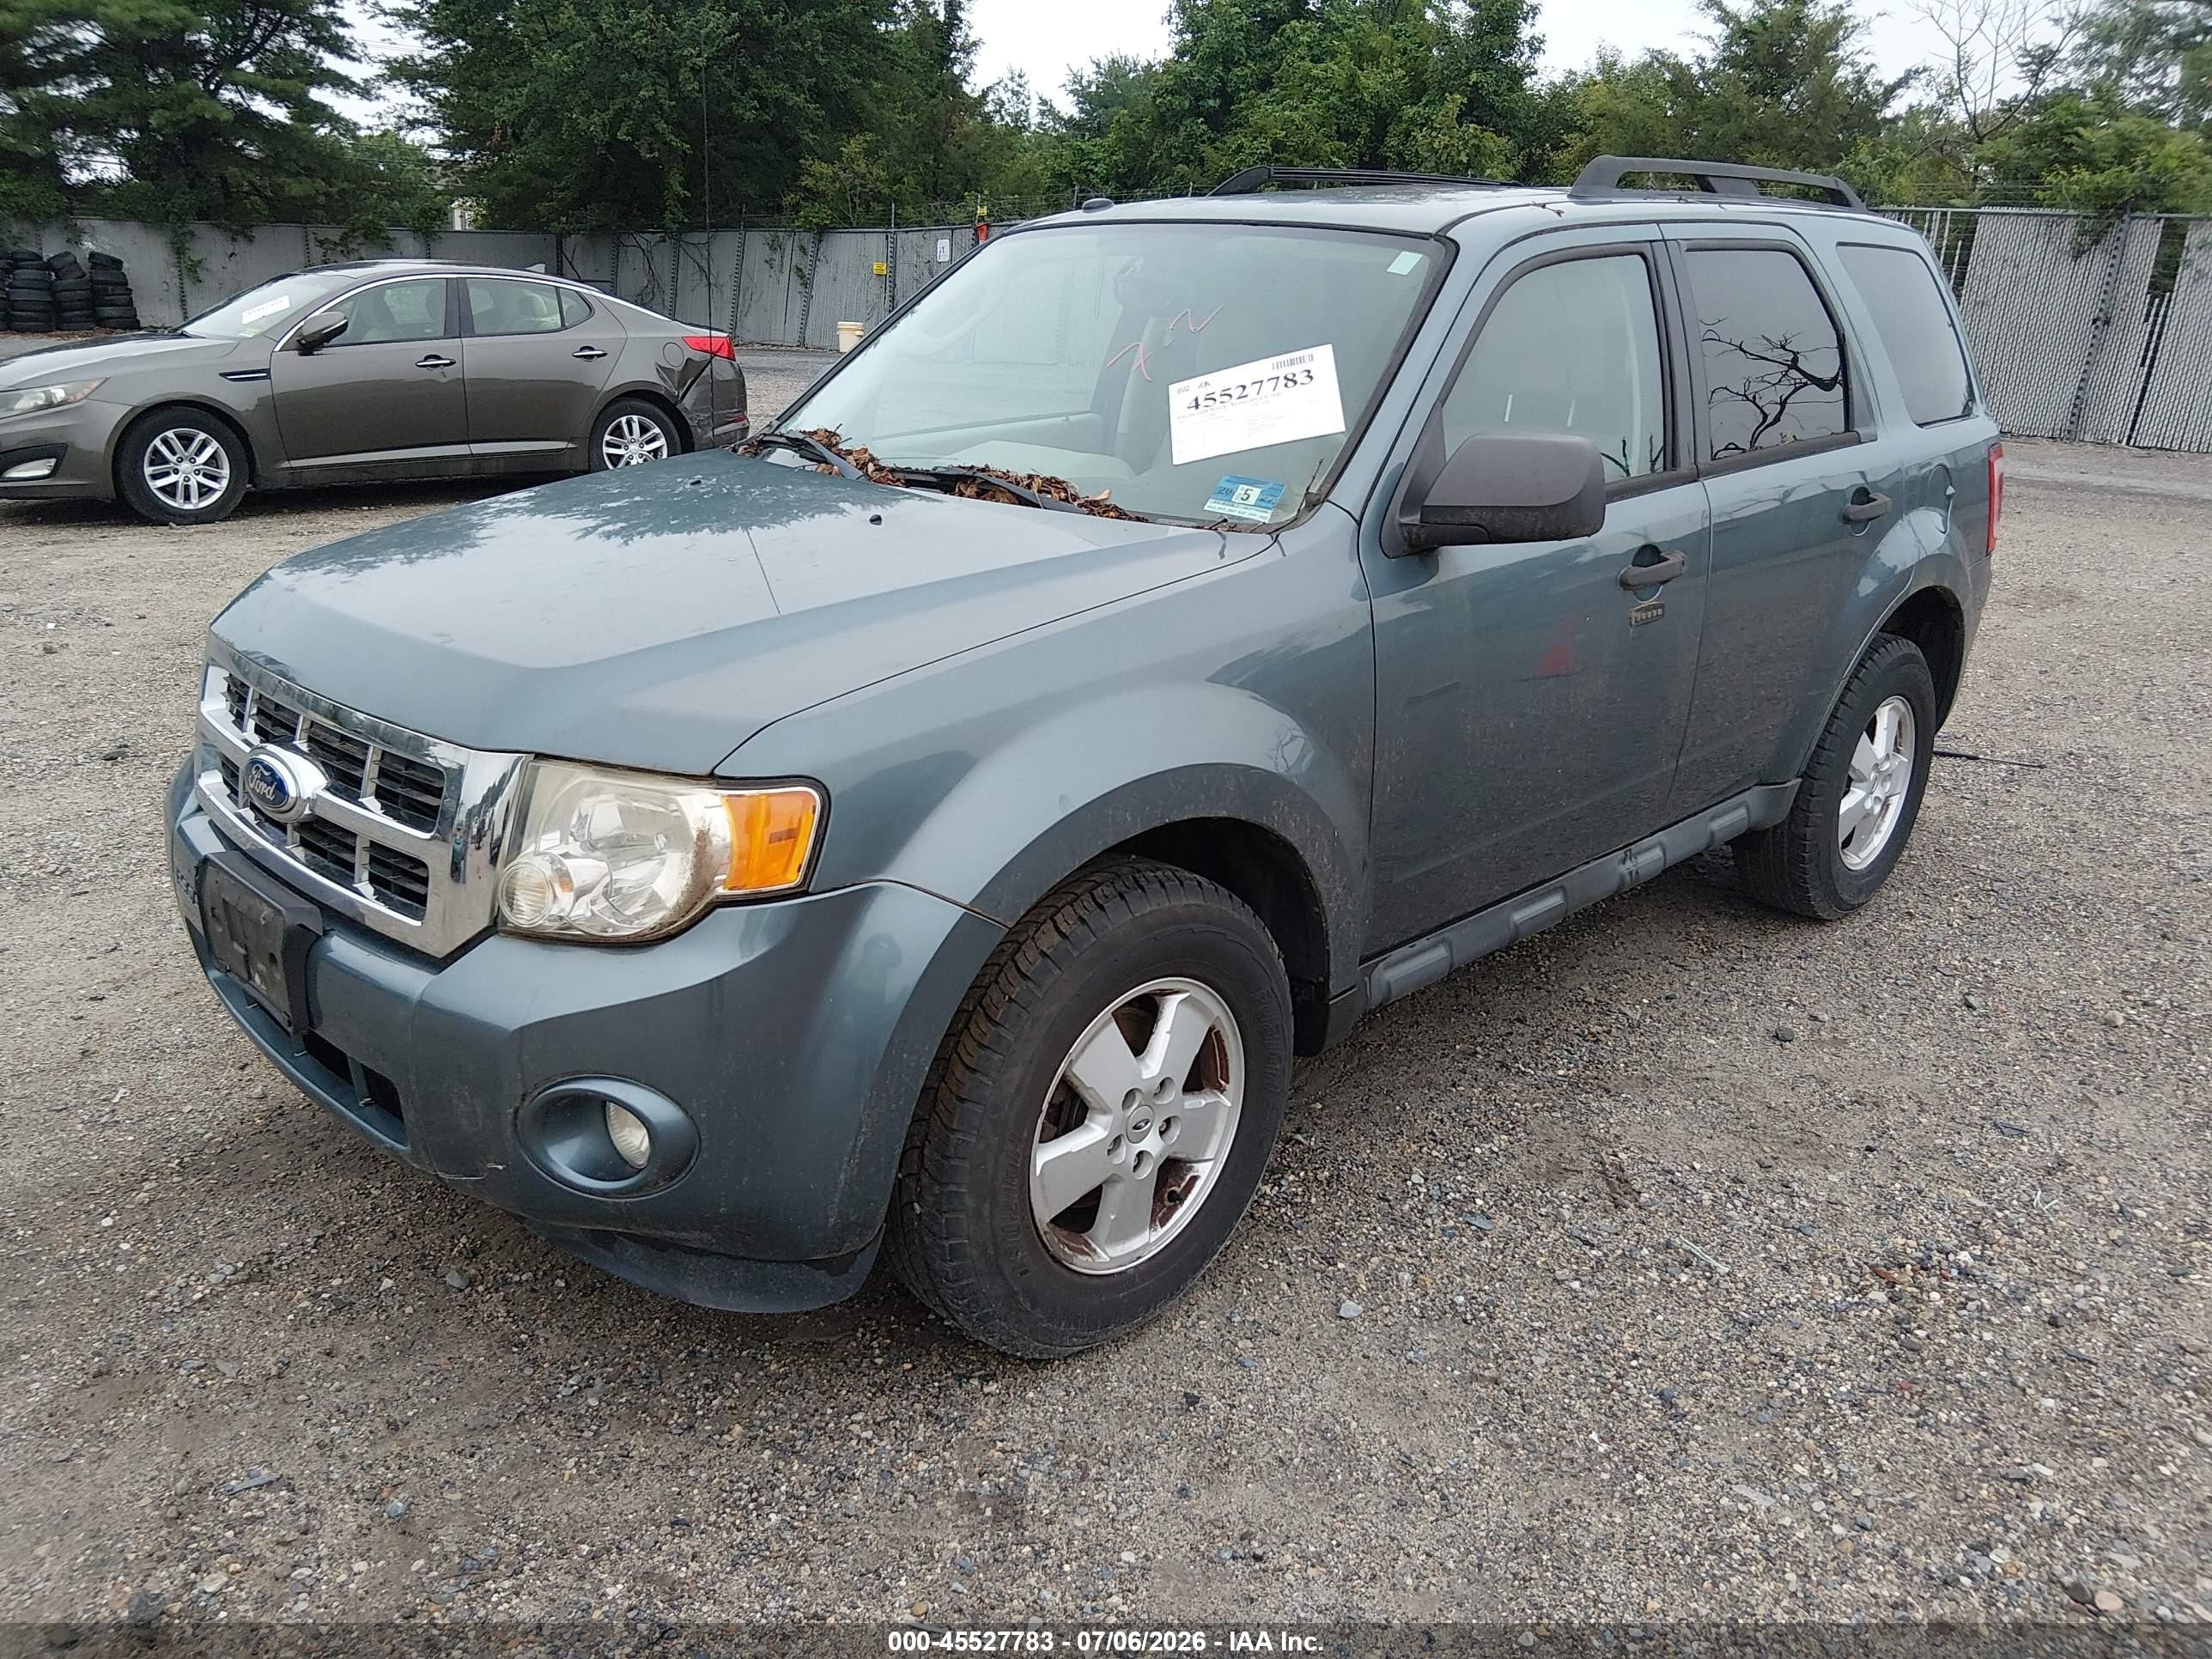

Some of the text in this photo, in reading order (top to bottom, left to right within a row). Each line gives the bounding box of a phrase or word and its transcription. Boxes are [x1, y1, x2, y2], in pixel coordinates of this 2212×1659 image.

[1187, 369, 1315, 410] 45527783
[1240, 489, 1254, 501] 5
[248, 763, 276, 800] Ford
